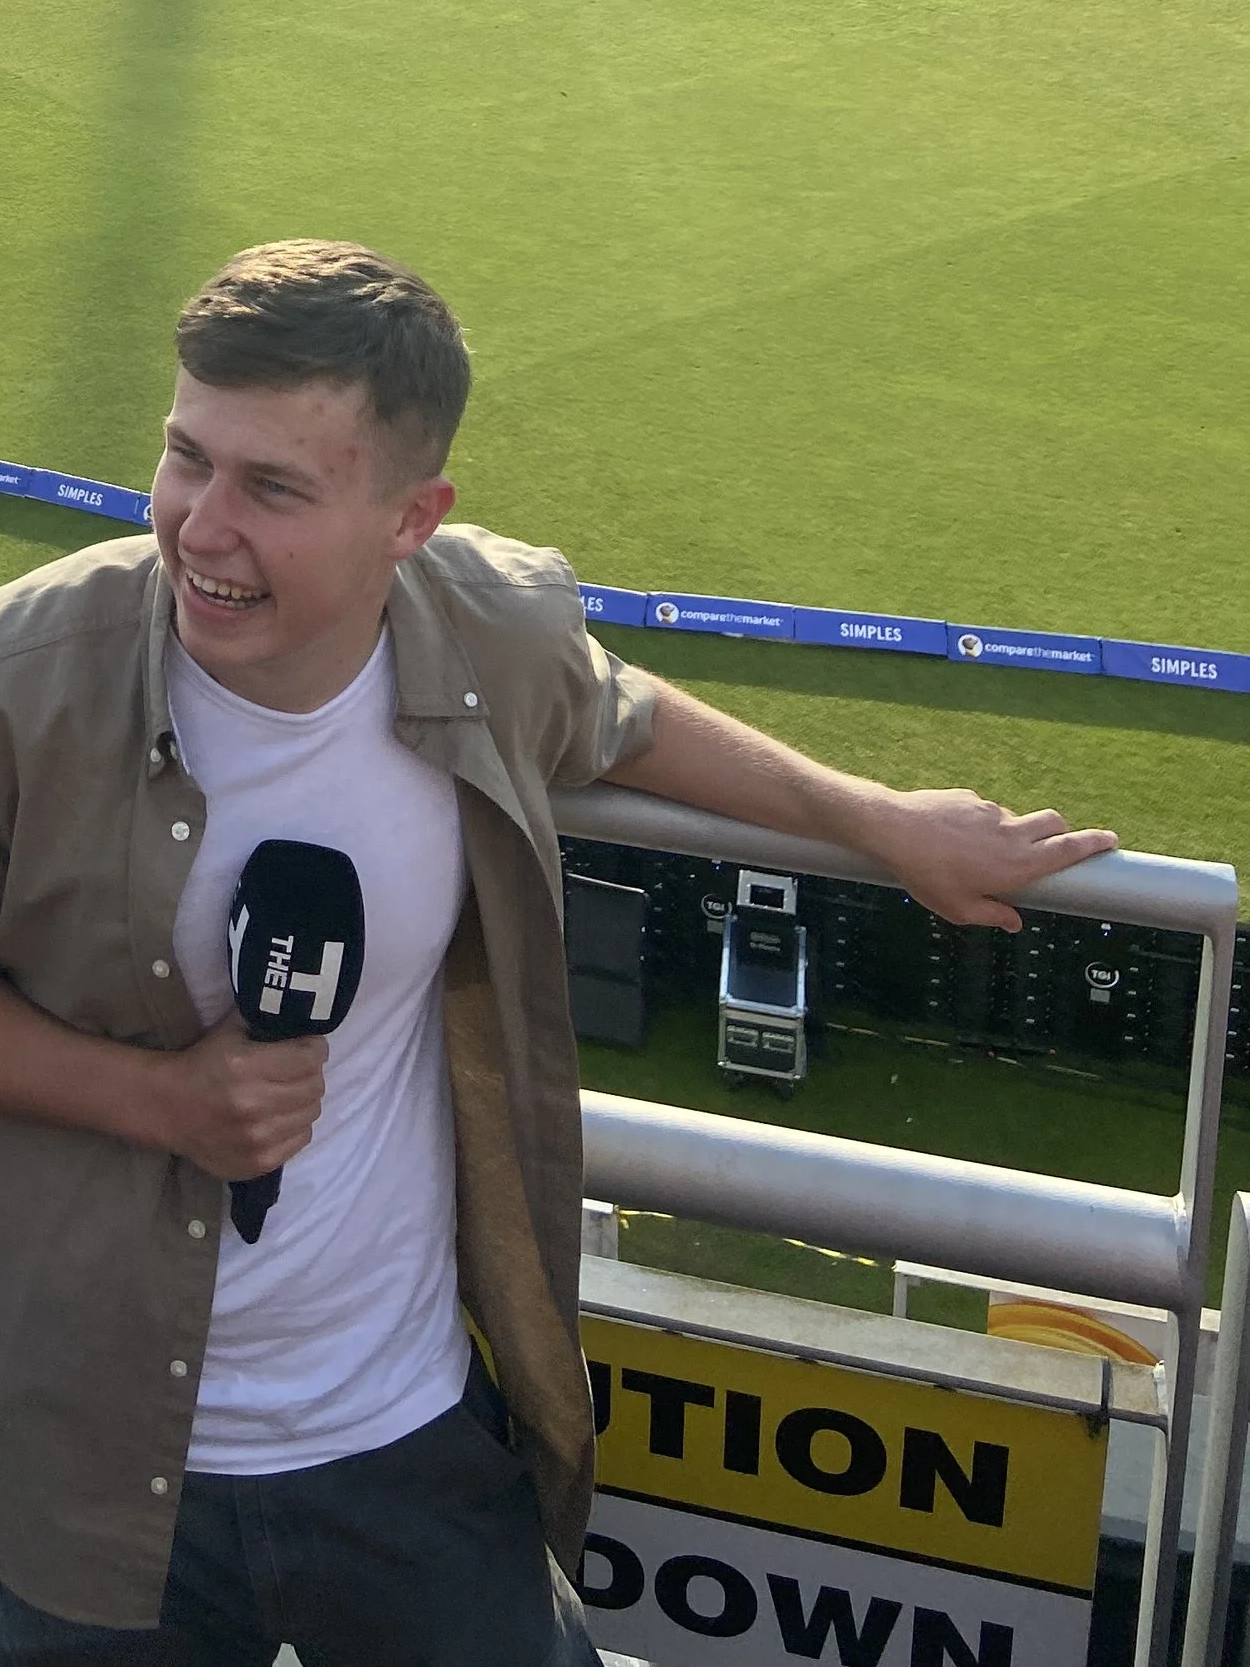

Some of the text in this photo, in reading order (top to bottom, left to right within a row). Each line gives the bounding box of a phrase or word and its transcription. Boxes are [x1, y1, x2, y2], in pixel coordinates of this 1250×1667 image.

[57, 483, 104, 507] SIMPLES
[840, 622, 903, 642] SIMPLES
[1151, 656, 1219, 680] SIMPLES
[264, 935, 294, 989] THE
